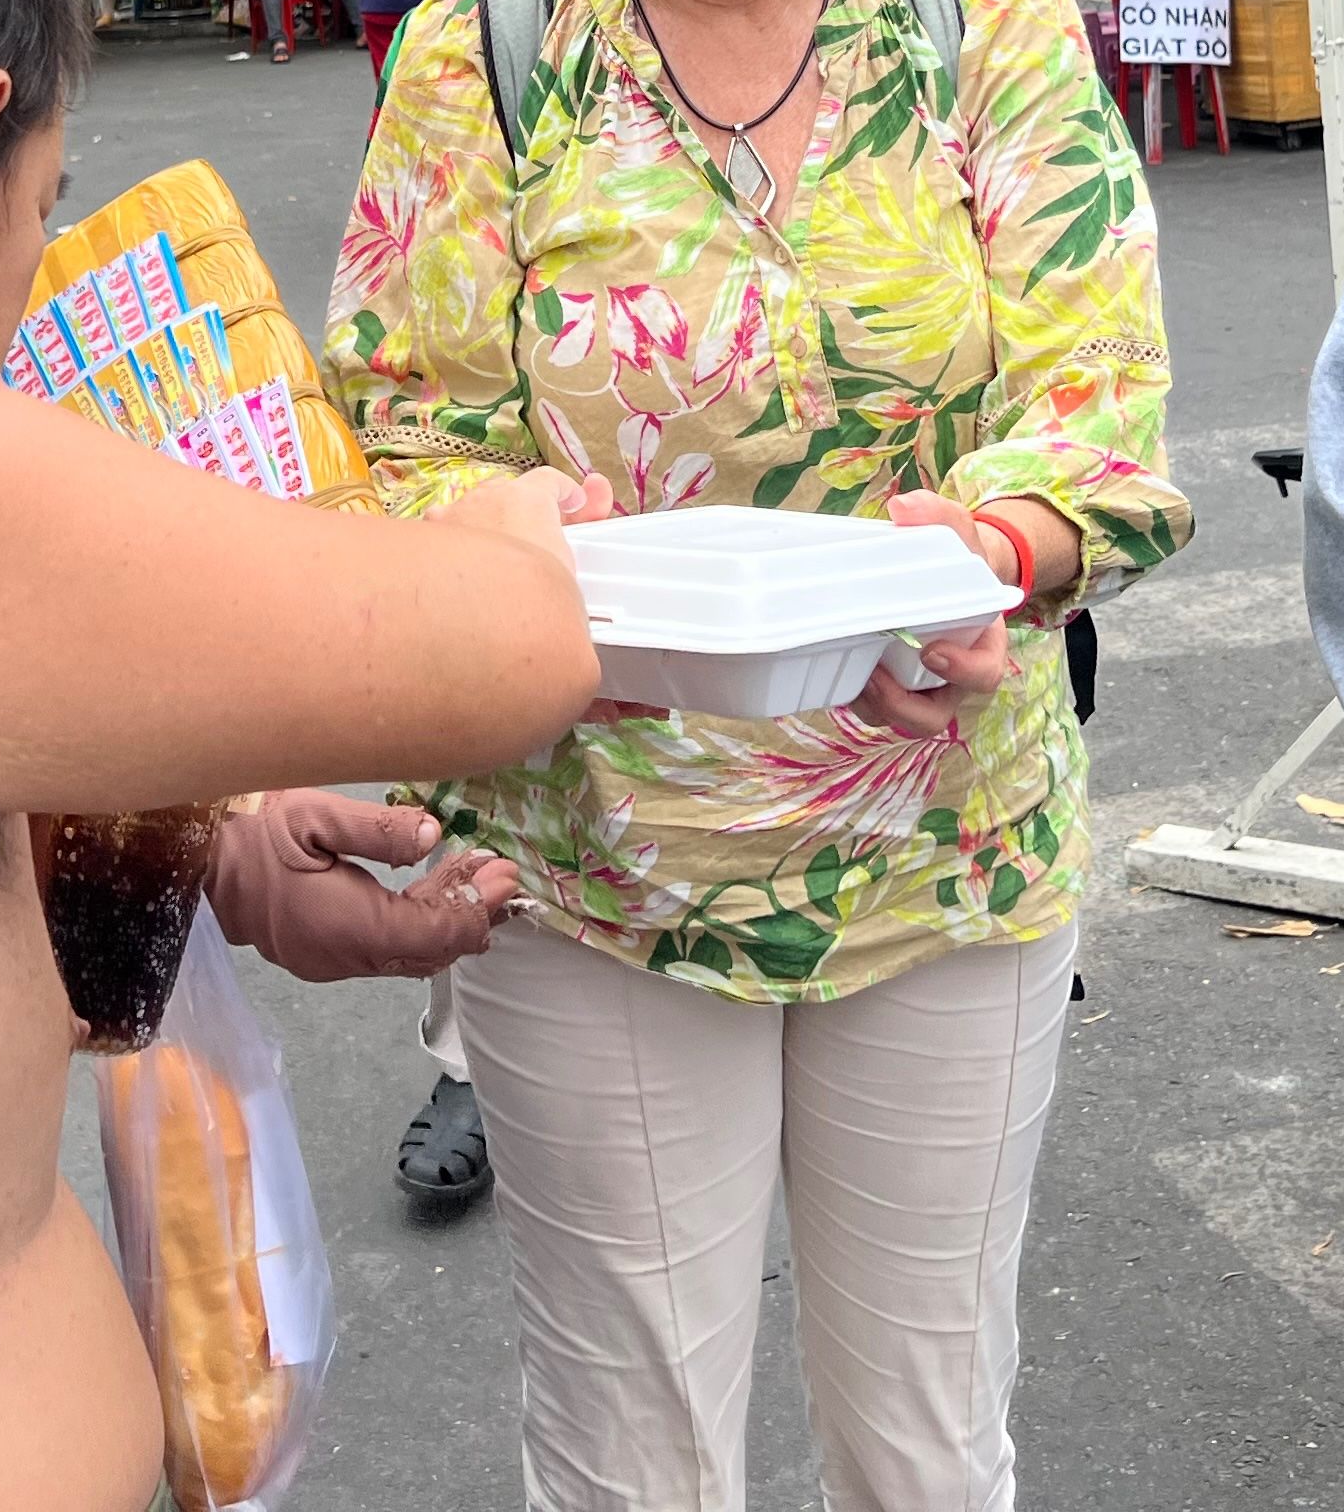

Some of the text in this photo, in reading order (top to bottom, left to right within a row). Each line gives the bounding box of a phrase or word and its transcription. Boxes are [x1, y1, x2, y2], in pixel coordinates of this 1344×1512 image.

[1122, 1, 1227, 33] CÓ NHẬN
[34, 318, 77, 387] 0713
